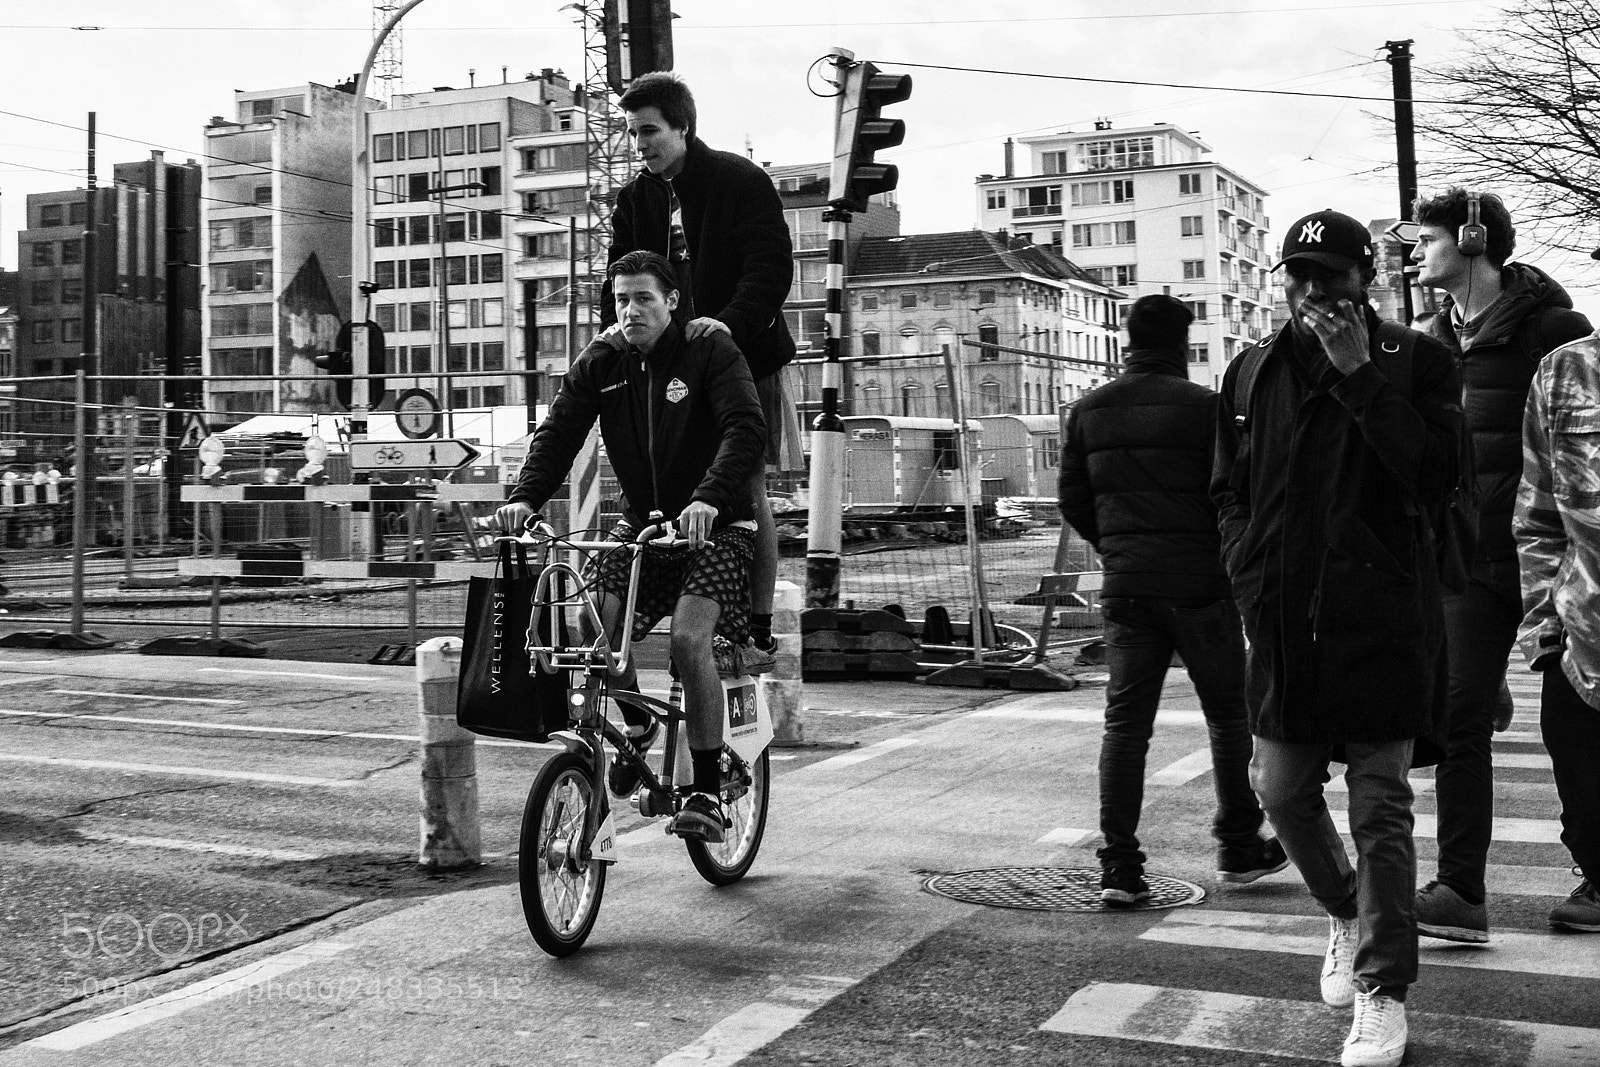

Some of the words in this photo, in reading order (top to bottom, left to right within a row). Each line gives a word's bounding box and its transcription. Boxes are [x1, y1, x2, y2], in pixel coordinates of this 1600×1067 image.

[1298, 220, 1326, 244] NY
[491, 601, 505, 694] WELLENS
[732, 696, 742, 719] A
